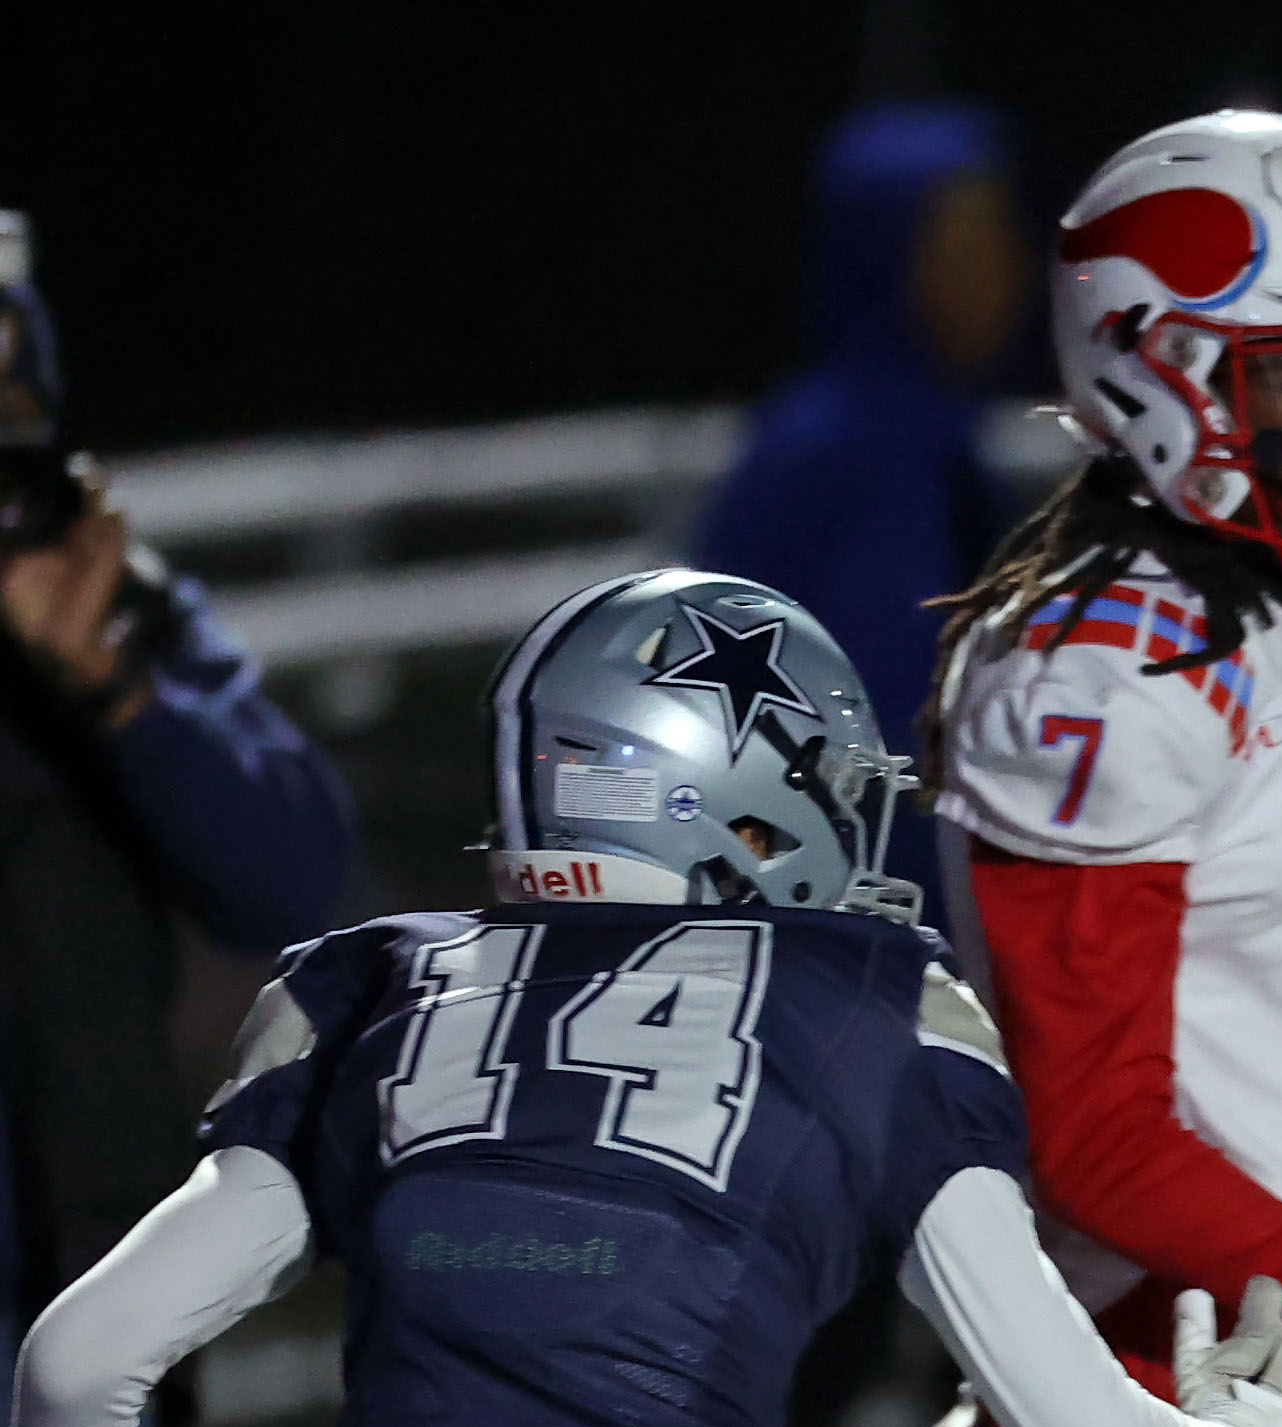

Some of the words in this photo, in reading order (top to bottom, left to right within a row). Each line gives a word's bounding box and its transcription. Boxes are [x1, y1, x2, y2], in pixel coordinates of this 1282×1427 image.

[1037, 714, 1105, 826] 7
[507, 861, 603, 898] dell
[378, 921, 774, 1193] 14
